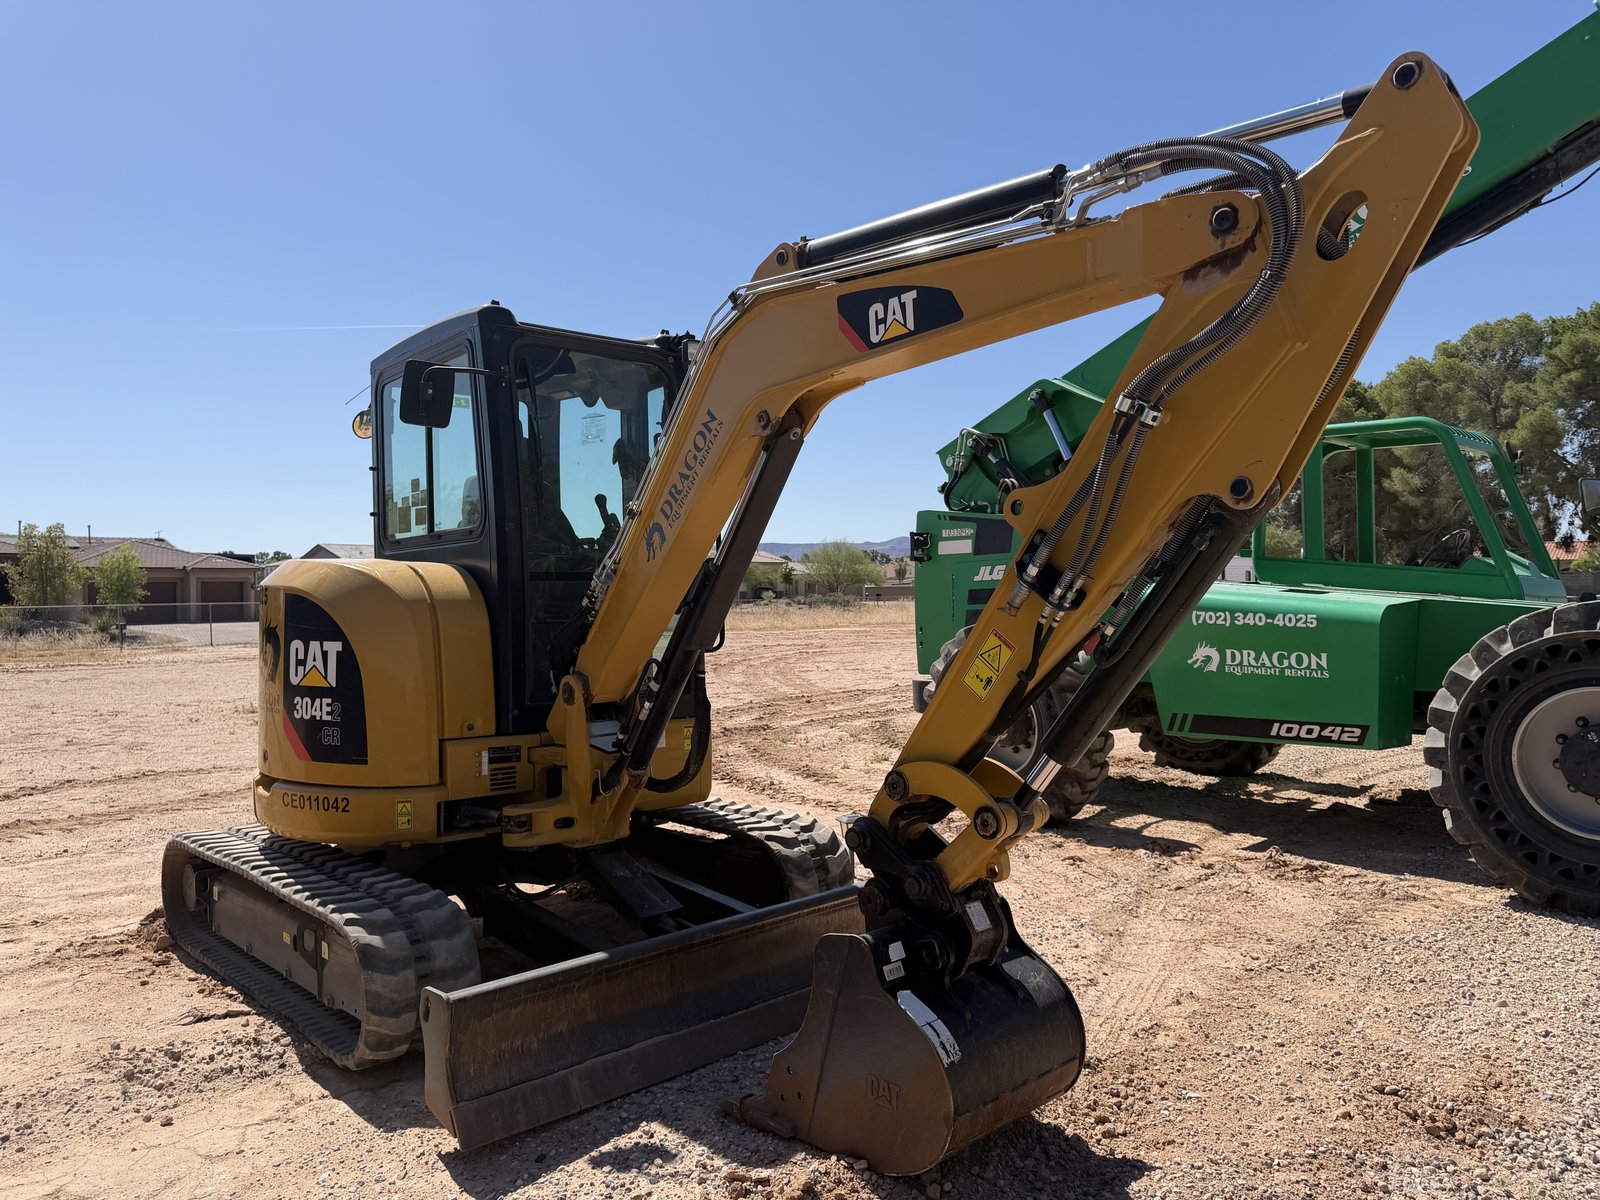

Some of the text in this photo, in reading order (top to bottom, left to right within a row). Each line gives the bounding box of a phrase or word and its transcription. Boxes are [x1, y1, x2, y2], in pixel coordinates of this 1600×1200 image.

[868, 289, 917, 343] CAT
[659, 408, 719, 520] DRAGON
[668, 419, 724, 529] EQUIPMENT RENTALS
[973, 564, 1007, 582] JLG
[1191, 611, 1318, 628] (702) 340-4025
[289, 639, 343, 688] CAT
[1225, 649, 1329, 670] DRAGON
[1225, 665, 1330, 679] EQUIPMENT RENTALS
[321, 726, 341, 745] CR
[1270, 722, 1362, 742] 10042
[282, 792, 350, 813] CE011042
[867, 1072, 901, 1111] CAT
